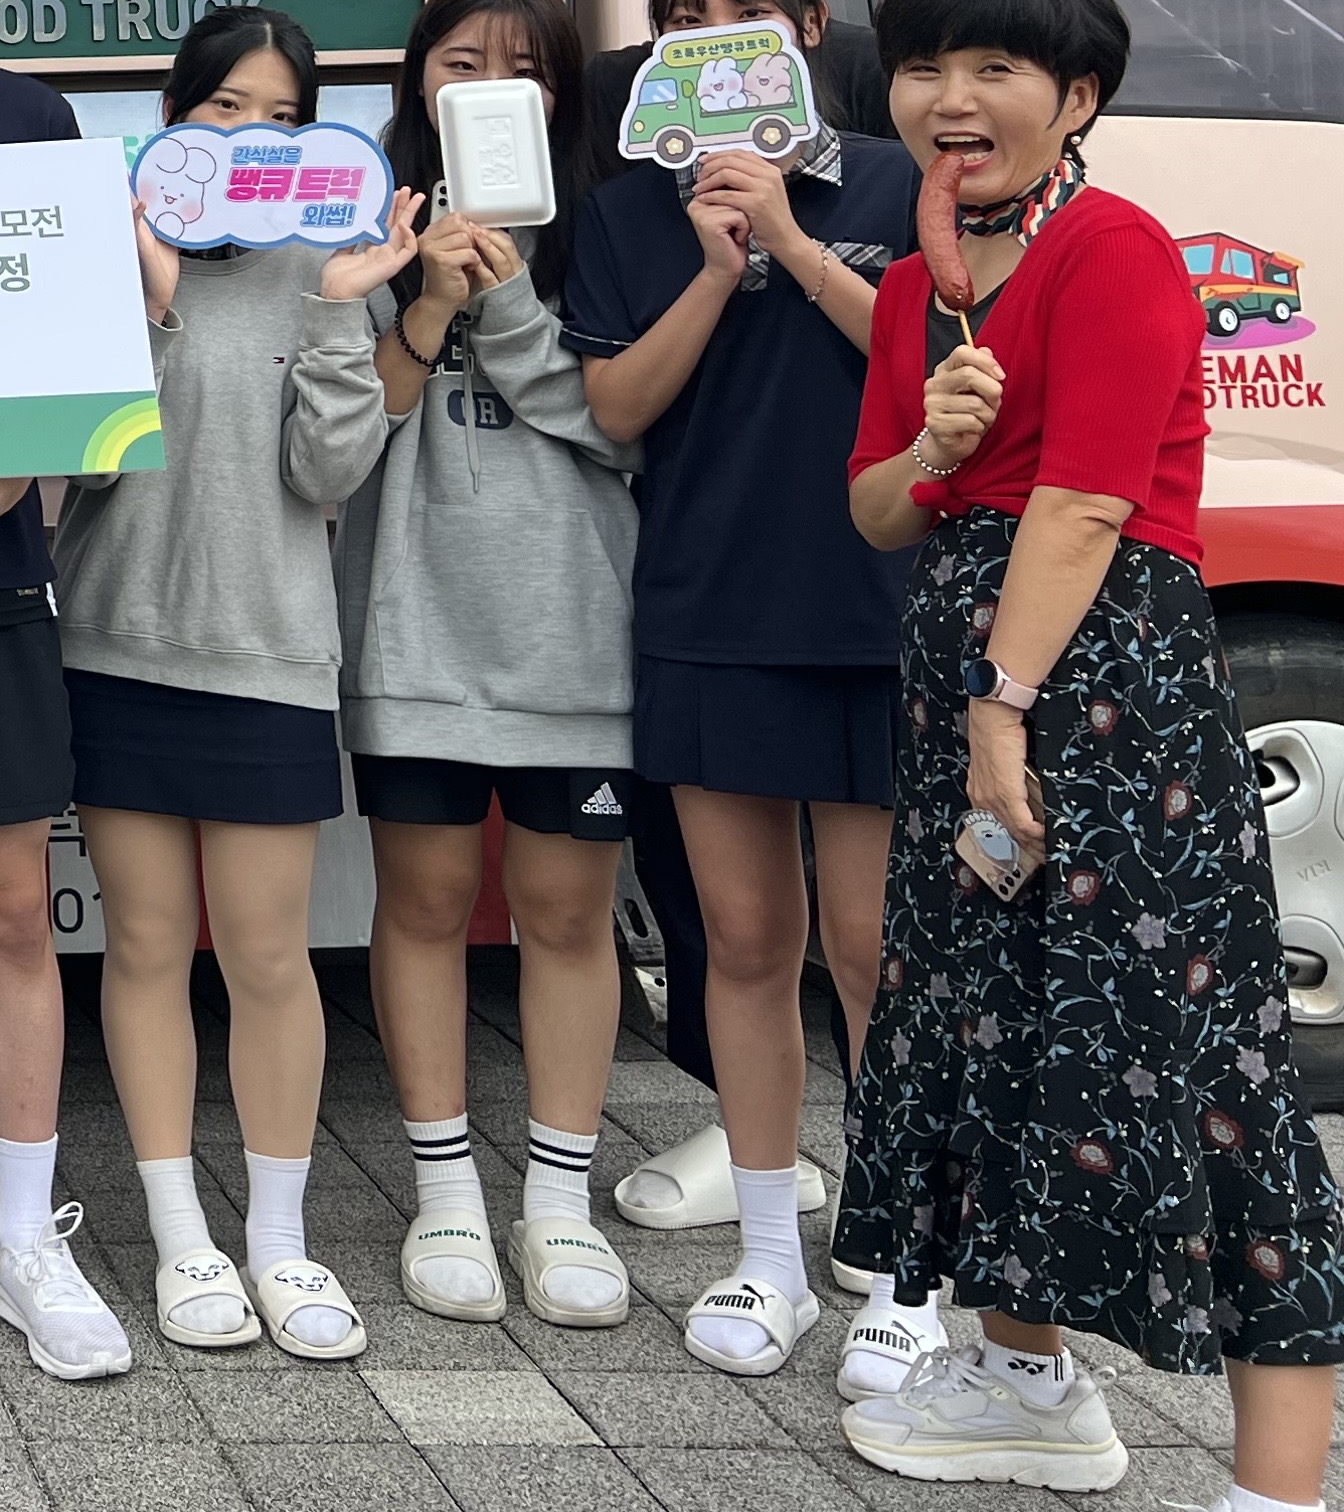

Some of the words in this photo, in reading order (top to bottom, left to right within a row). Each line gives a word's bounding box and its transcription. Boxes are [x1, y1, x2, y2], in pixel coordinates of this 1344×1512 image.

[673, 37, 771, 59] 초록우산땡큐트럭
[231, 145, 303, 166] 간식실은
[292, 166, 366, 202] 트럭
[300, 203, 356, 227] 와썹!
[581, 802, 623, 815] adidas
[418, 1229, 481, 1241] UMBRO
[545, 1238, 609, 1255] UMBRO
[704, 1294, 756, 1310] PUMA
[852, 1327, 911, 1352] PUMA
